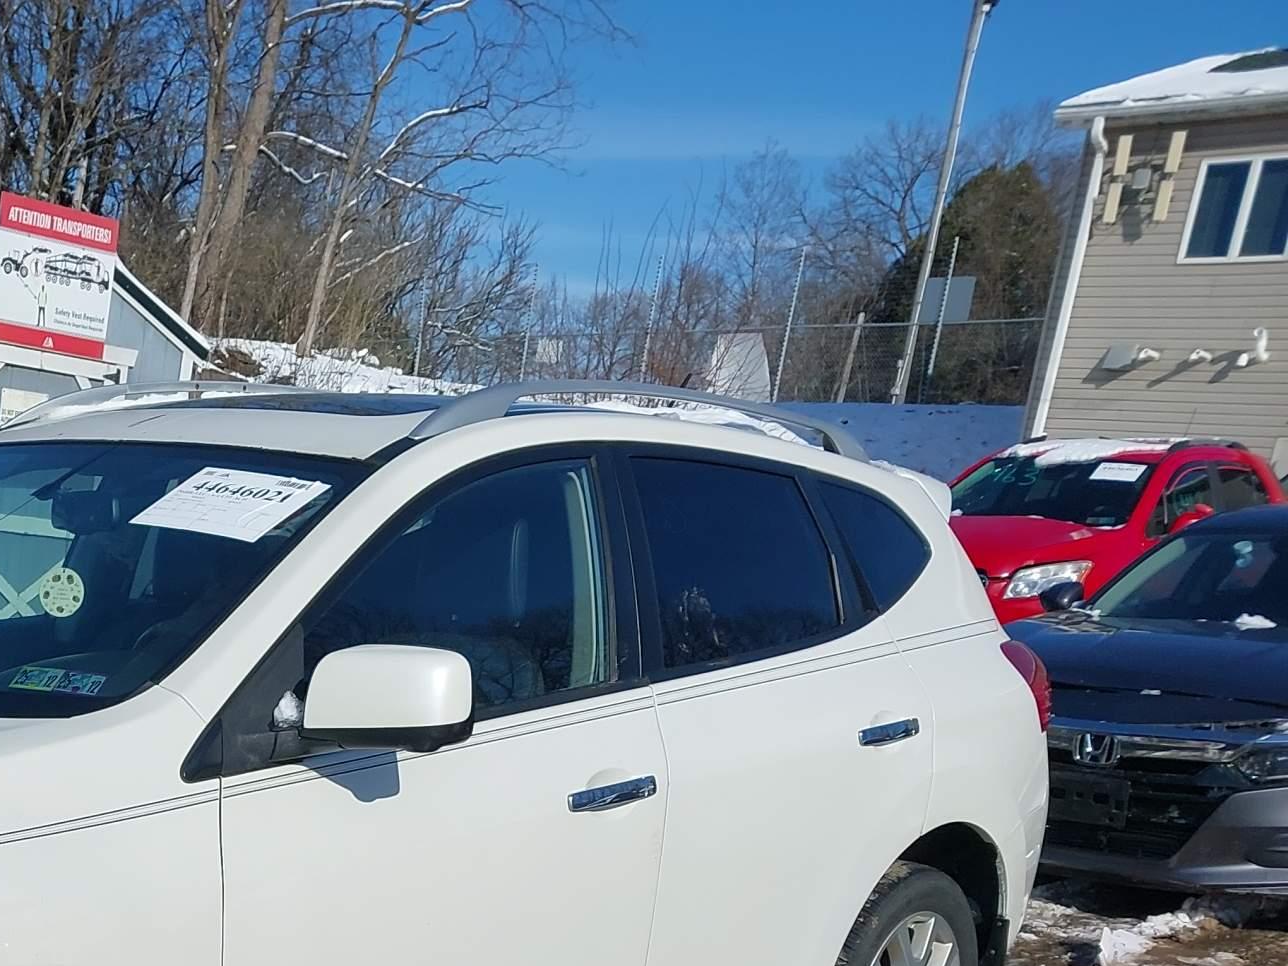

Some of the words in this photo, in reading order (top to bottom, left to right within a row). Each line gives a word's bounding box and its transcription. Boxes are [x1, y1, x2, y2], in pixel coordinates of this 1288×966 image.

[8, 206, 51, 230] ATTENTION
[53, 216, 112, 244] TRANSPORTERS!
[193, 480, 293, 503] 44646021
